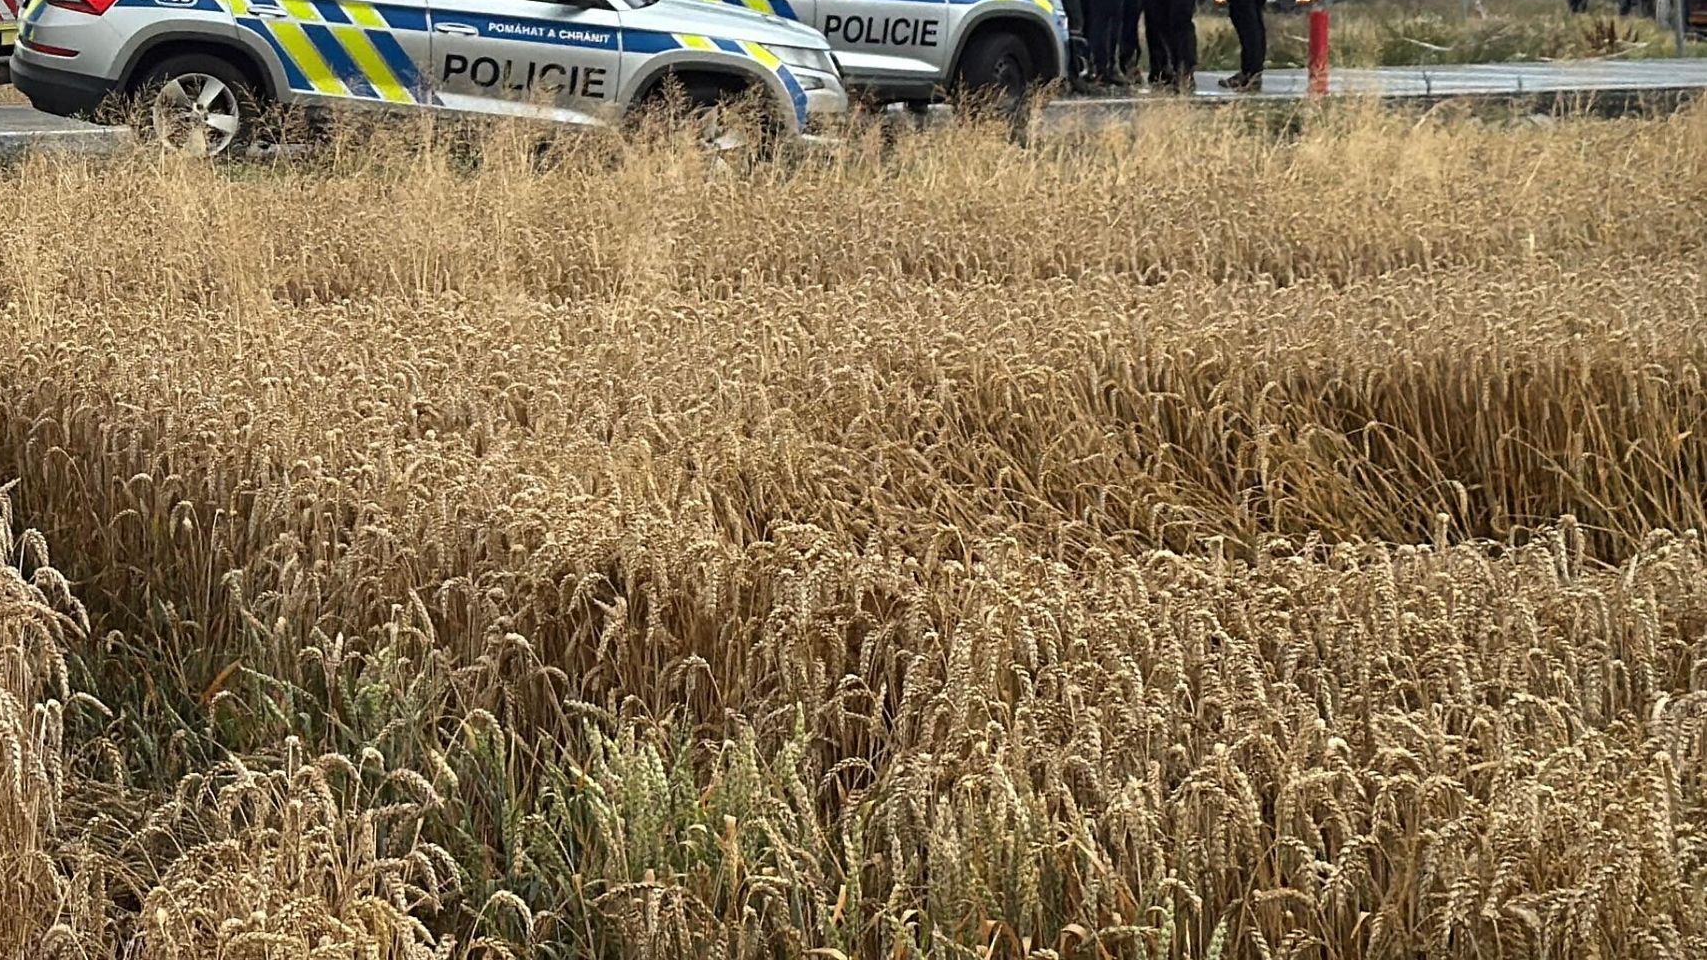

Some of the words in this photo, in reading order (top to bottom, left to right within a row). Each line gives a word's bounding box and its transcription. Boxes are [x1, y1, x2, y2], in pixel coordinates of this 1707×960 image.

[488, 21, 546, 38] POMÁHAT
[547, 29, 557, 38] A
[558, 29, 611, 44] CHRÁNIT
[824, 14, 940, 48] POLICIE
[442, 52, 608, 99] POLICIE
